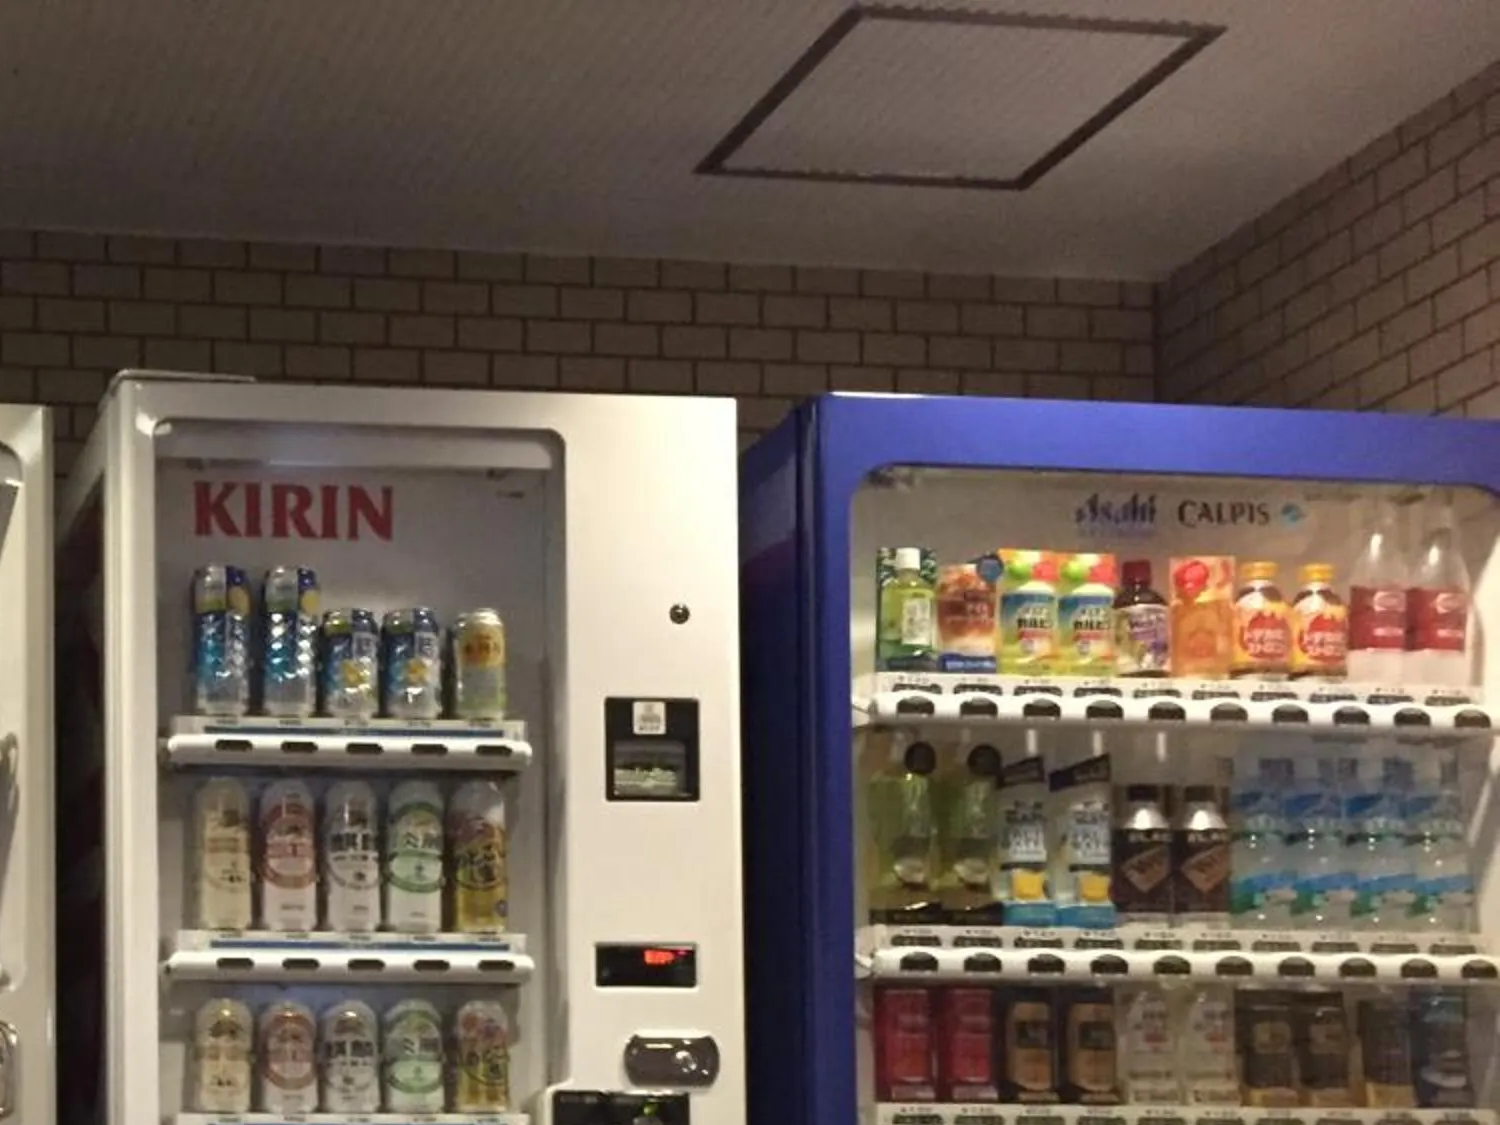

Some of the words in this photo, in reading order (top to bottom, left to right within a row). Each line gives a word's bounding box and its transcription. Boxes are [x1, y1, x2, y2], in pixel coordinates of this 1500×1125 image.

[193, 481, 394, 541] KIRIN
[1074, 492, 1157, 525] Asahi
[1176, 498, 1271, 528] CALPIS
